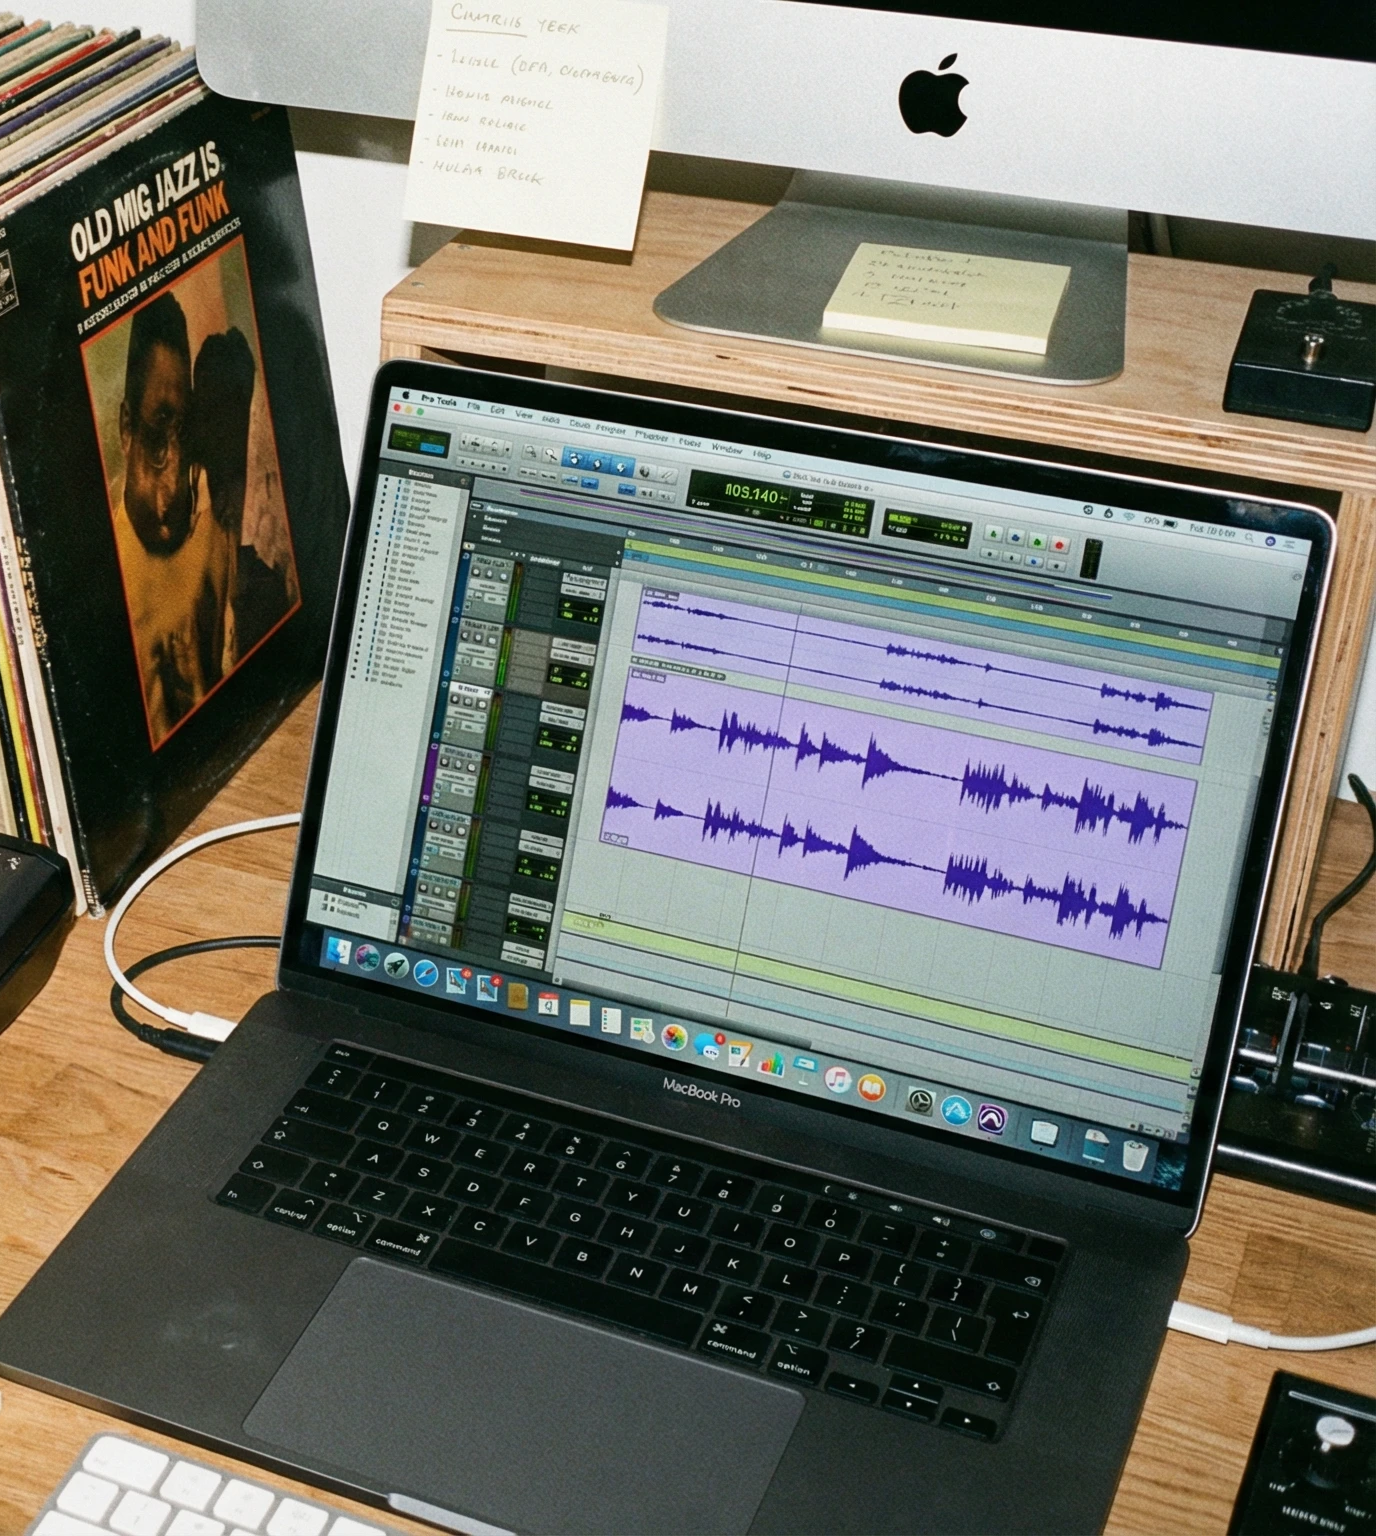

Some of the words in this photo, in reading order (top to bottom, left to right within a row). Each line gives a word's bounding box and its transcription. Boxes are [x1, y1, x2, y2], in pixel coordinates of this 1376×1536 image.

[70, 208, 114, 263] OLD
[113, 183, 155, 237] MIG
[155, 150, 201, 213] JAZZ
[199, 140, 221, 183] IS
[77, 242, 138, 309] FUNK
[137, 215, 178, 272] AND
[176, 180, 231, 243] FUNK
[662, 1076, 719, 1103] MacBook
[719, 1092, 742, 1110] Pro
[377, 1121, 390, 1131] Q
[424, 1133, 441, 1144] W
[474, 1148, 486, 1159] E
[523, 1162, 536, 1173] R
[576, 1176, 587, 1187] T
[628, 1191, 638, 1202] Y
[677, 1206, 691, 1218] U
[838, 1252, 851, 1262] P
[417, 1104, 429, 1113] 2
[466, 1118, 477, 1127] 3
[615, 1160, 626, 1170] 6
[668, 1174, 678, 1183] 7
[771, 1204, 782, 1213] 9
[367, 1153, 379, 1164] A
[417, 1167, 430, 1178] S
[466, 1181, 480, 1192] D
[519, 1197, 531, 1206] F
[569, 1212, 582, 1223] G
[620, 1226, 634, 1238] H
[674, 1245, 686, 1254] J
[727, 1258, 740, 1269] K
[782, 1274, 791, 1285] L
[372, 1190, 386, 1201] Z
[421, 1205, 436, 1217] X
[473, 1221, 486, 1231] C
[526, 1235, 538, 1246] V
[576, 1251, 588, 1262] B
[629, 1267, 644, 1278] N
[682, 1283, 698, 1295] M
[777, 1361, 810, 1375] option
